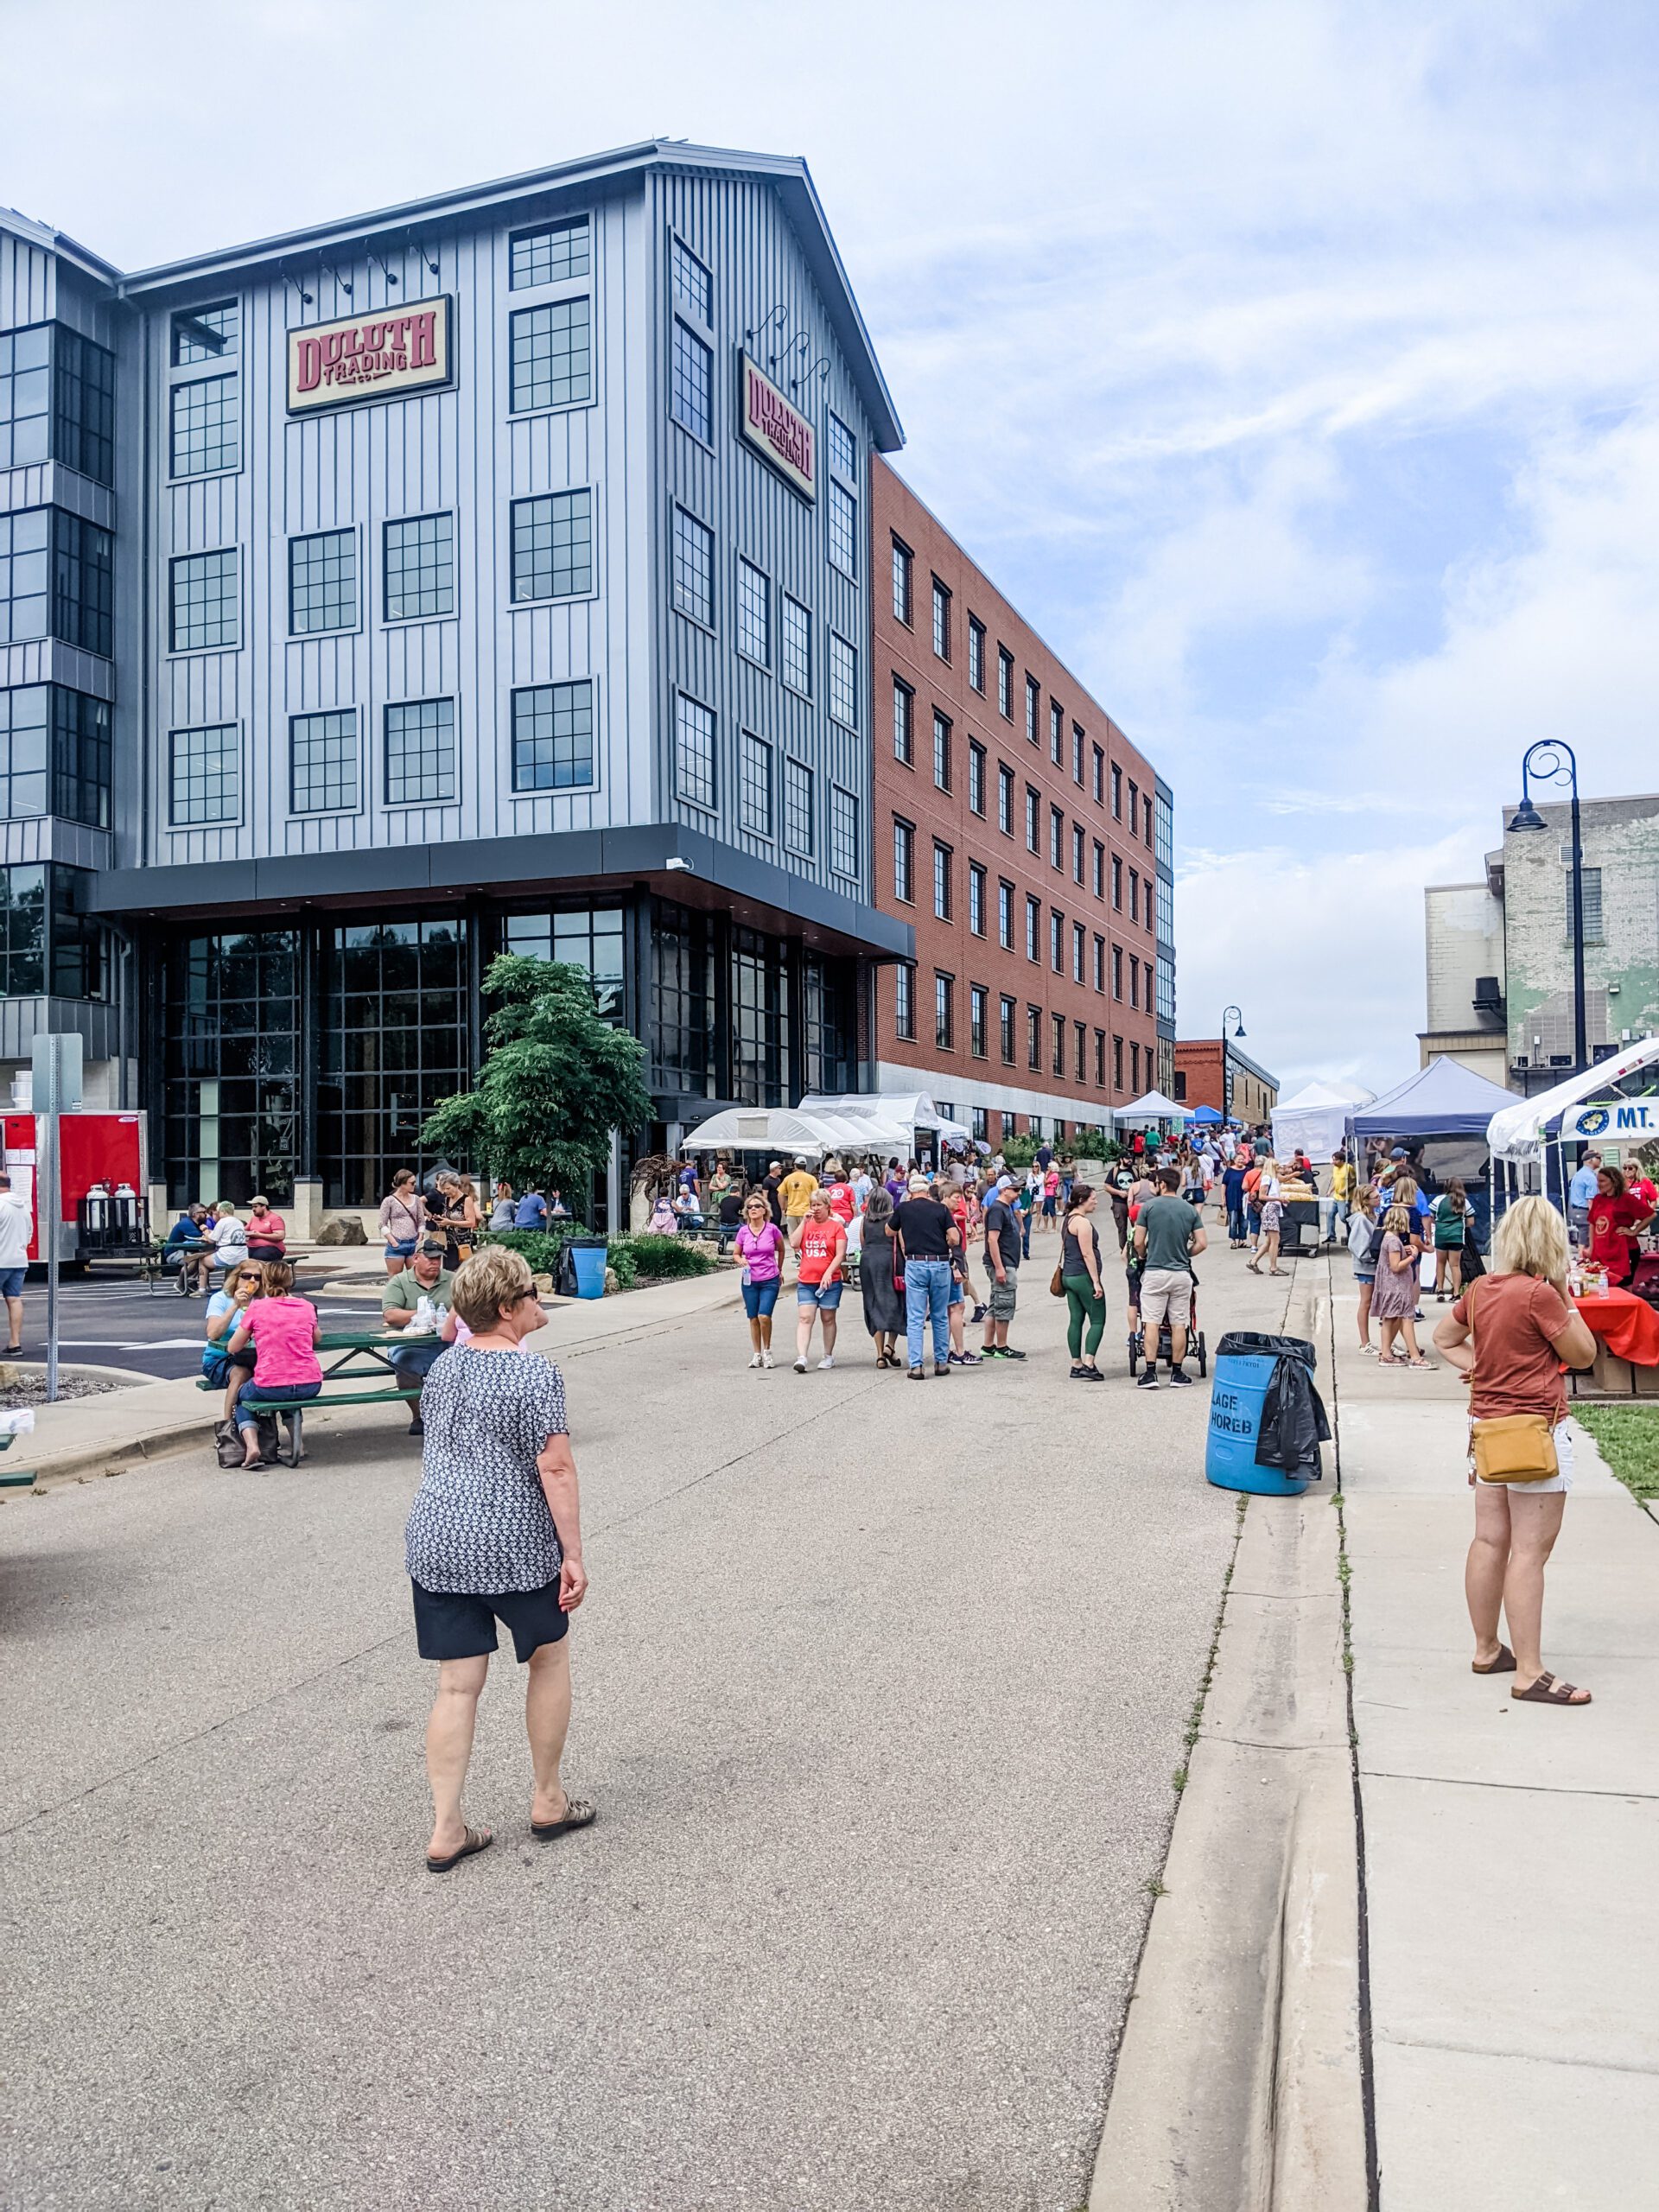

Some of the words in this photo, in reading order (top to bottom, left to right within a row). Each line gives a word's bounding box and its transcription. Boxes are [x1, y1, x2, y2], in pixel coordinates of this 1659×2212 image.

[296, 311, 436, 392] DULUTH
[323, 351, 407, 385] TRADING
[358, 374, 372, 383] CO
[749, 369, 812, 481] DULUTH
[1617, 1107, 1655, 1128] MT.
[830, 1188, 845, 1199] 20
[805, 1240, 827, 1249] USA
[805, 1249, 827, 1257] USA
[1211, 1410, 1253, 1434] HOREB
